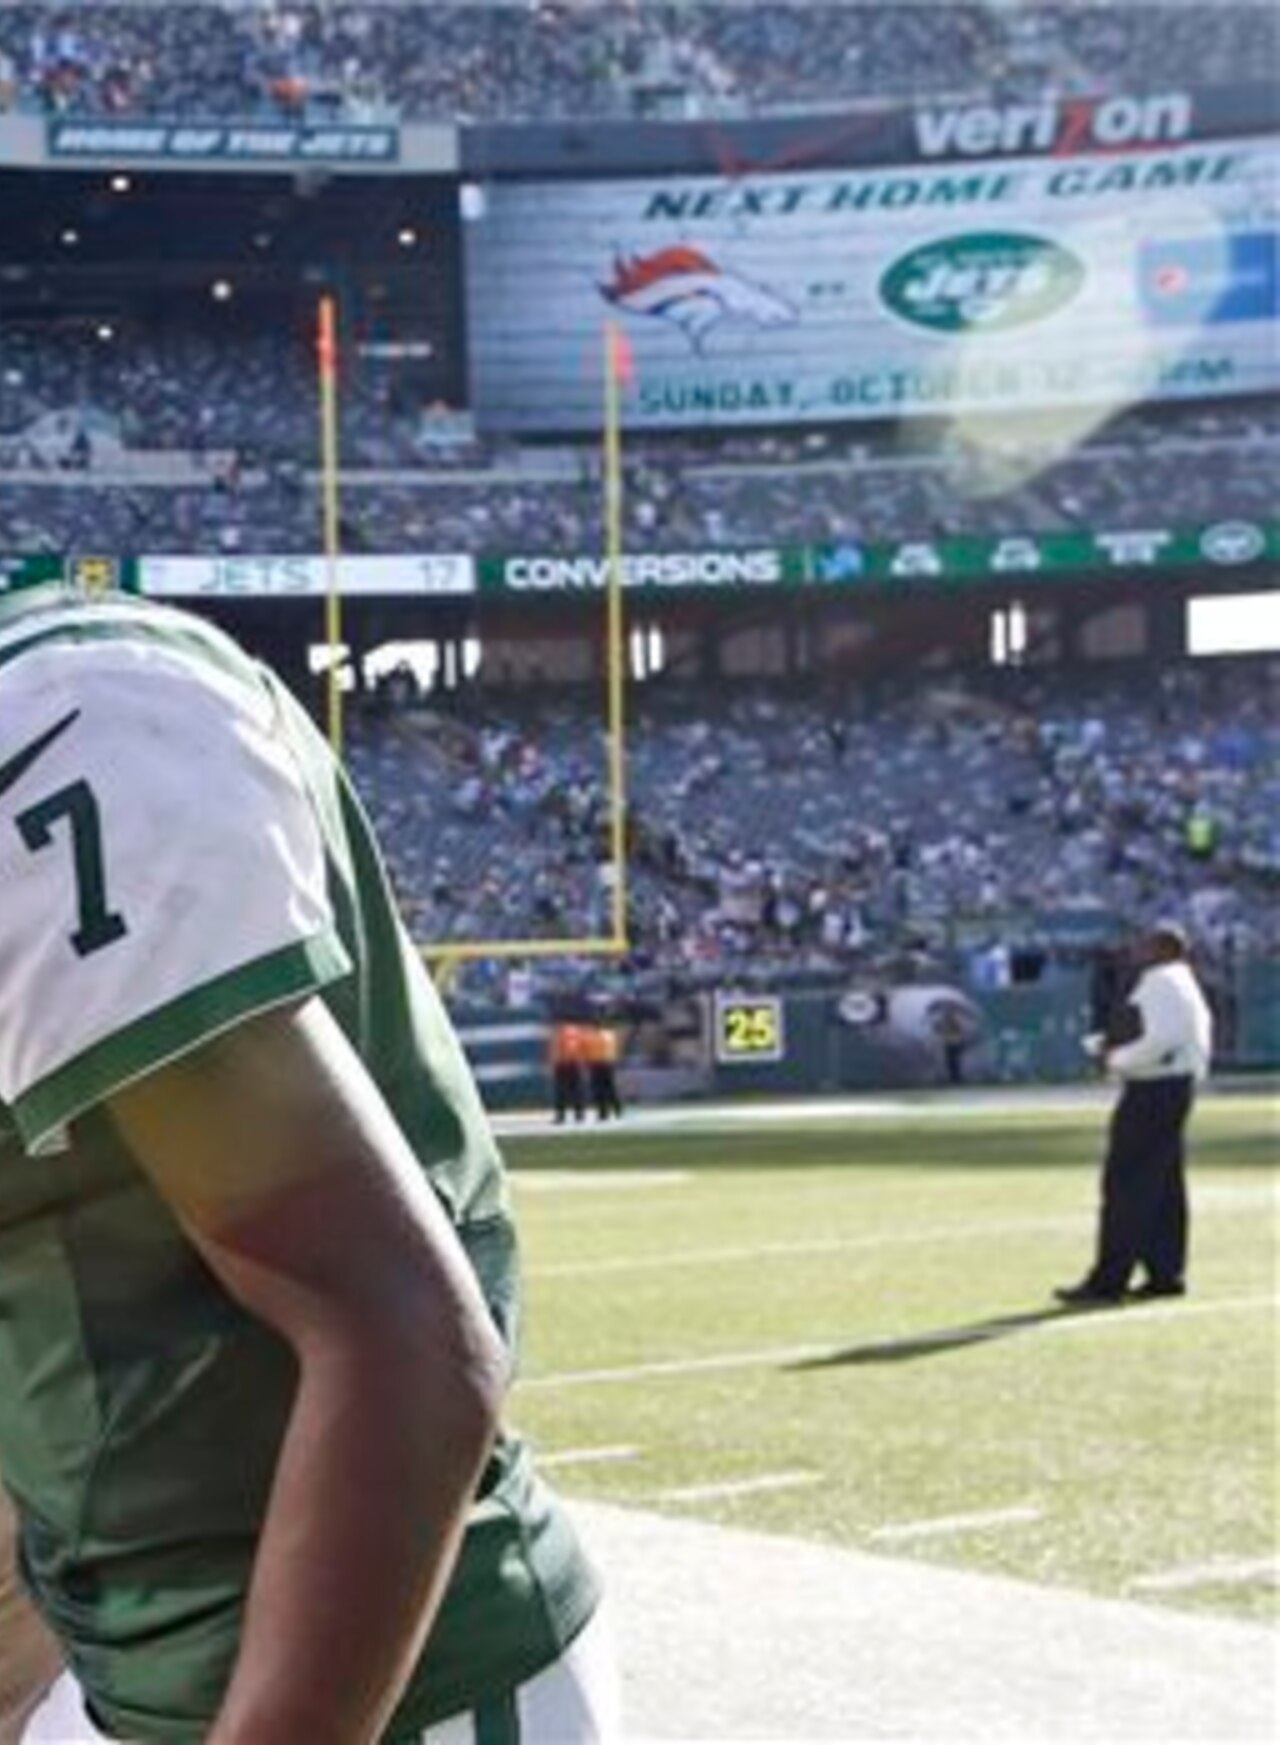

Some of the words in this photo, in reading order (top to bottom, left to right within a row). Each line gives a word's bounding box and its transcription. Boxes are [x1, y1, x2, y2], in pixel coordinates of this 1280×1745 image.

[170, 130, 221, 153] OF
[300, 132, 390, 155] JETS
[915, 90, 1192, 160] verizon
[641, 183, 809, 221] NEXT
[825, 175, 1018, 215] HOME
[1048, 155, 1246, 198] GAME
[200, 558, 314, 591] JETS
[417, 560, 460, 588] 17
[503, 551, 782, 590] CONVERSIONS
[14, 777, 128, 959] 7
[726, 1008, 778, 1049] 25
